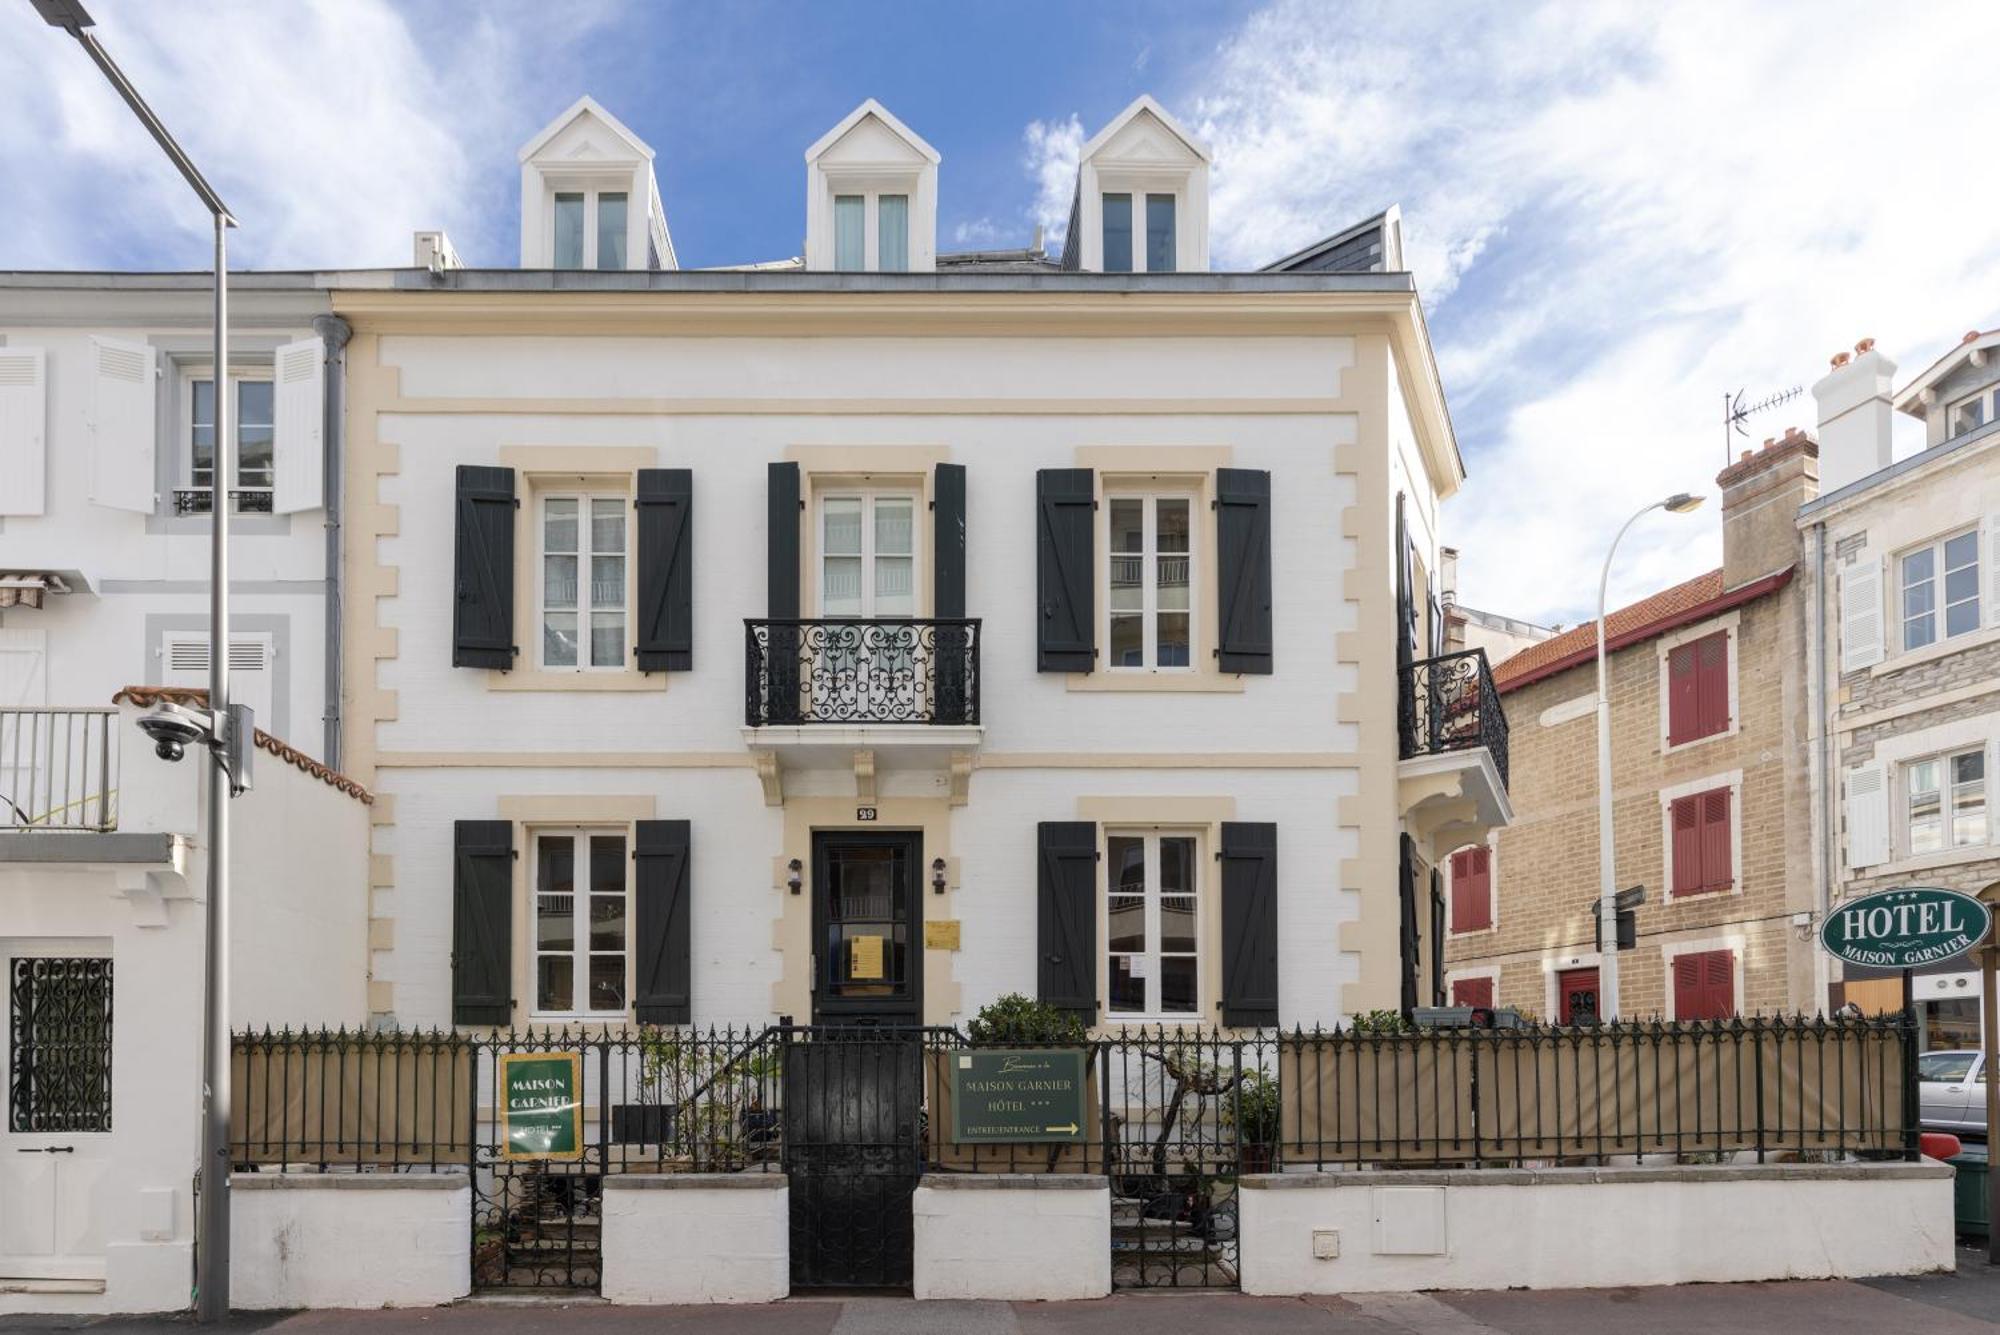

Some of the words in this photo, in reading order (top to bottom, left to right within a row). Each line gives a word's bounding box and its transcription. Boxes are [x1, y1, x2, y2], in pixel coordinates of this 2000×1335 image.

[1842, 900, 1965, 941] HOTEL
[1842, 944, 1896, 964] MAISON
[1904, 934, 1971, 964] GARNIER
[512, 1079, 565, 1091] MAISON
[965, 1079, 1014, 1092] MAISON
[1018, 1079, 1072, 1091] GARNIER
[510, 1096, 570, 1108] GARNIER
